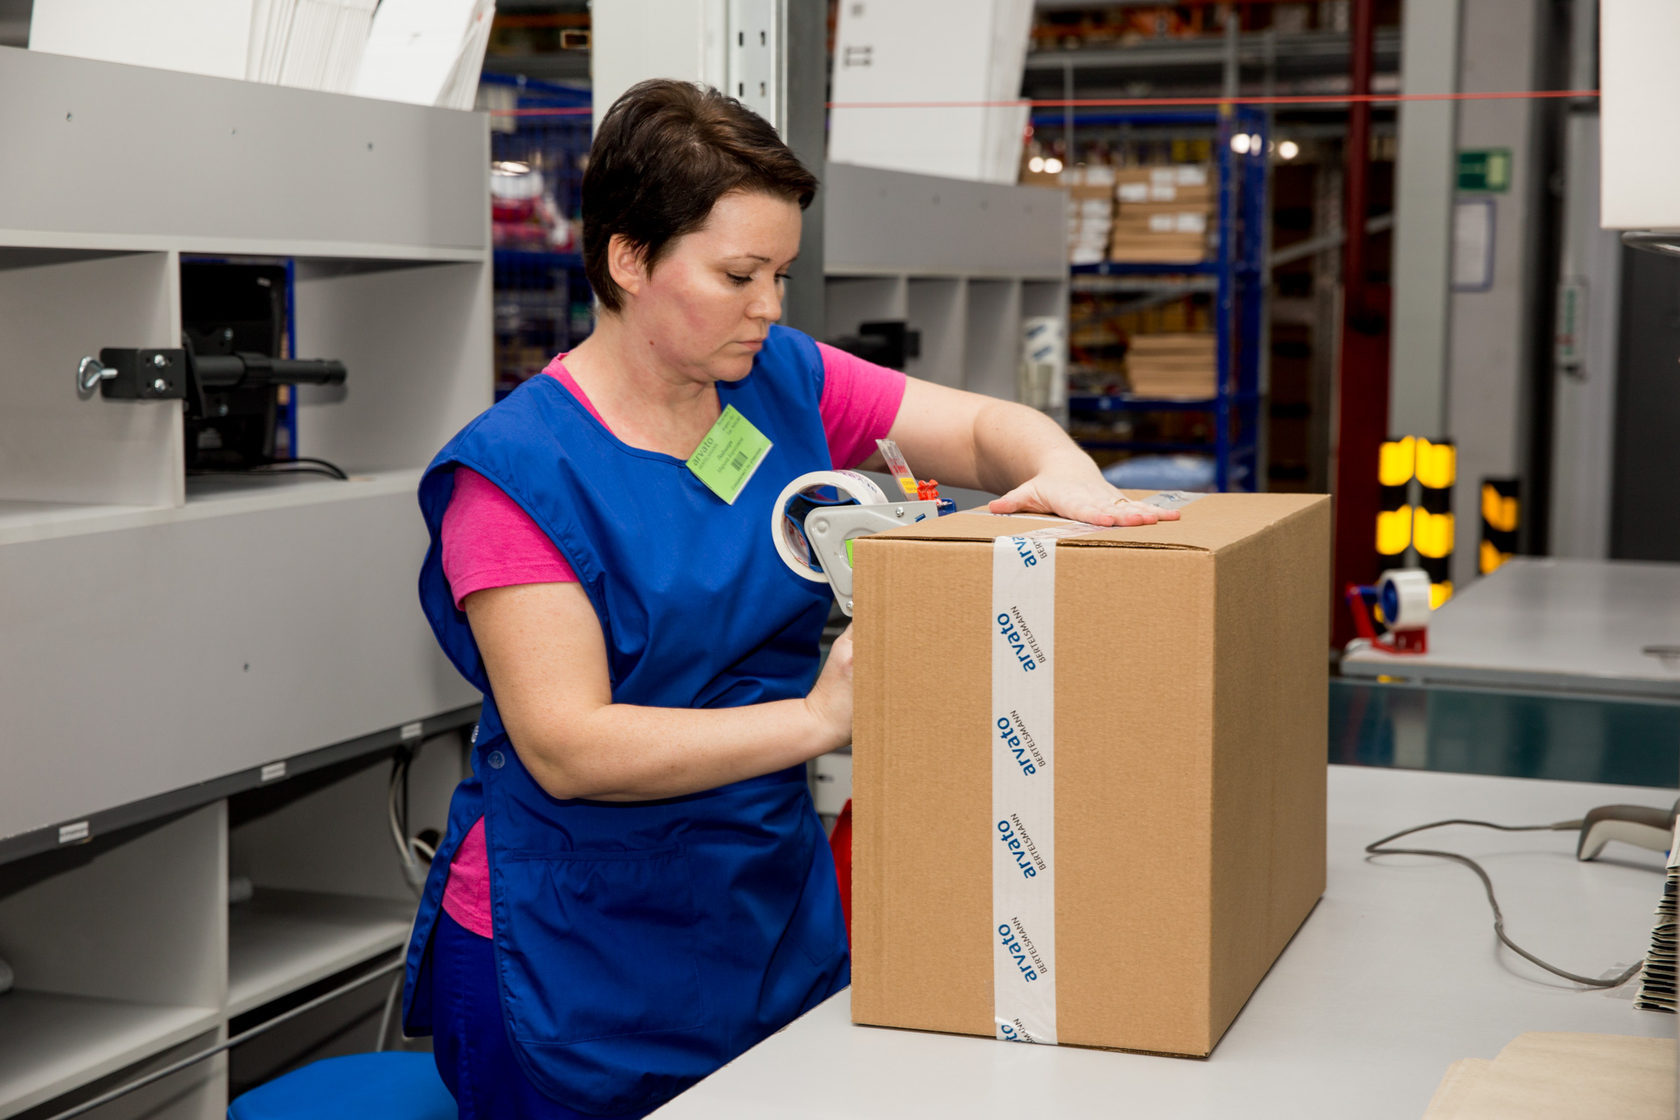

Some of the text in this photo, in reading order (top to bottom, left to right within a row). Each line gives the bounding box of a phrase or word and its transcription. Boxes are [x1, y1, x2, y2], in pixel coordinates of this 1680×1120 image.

[997, 613, 1036, 672] arvato
[1010, 606, 1046, 663] BERTELSMANN
[997, 717, 1036, 776] arvato
[1010, 710, 1046, 767] BERTELSMANN
[997, 820, 1036, 879] arvato
[1010, 813, 1047, 871] BERTELSMANN
[998, 924, 1037, 982] arvato
[1011, 916, 1048, 974] BERTELSMANN
[1001, 1024, 1021, 1042] to
